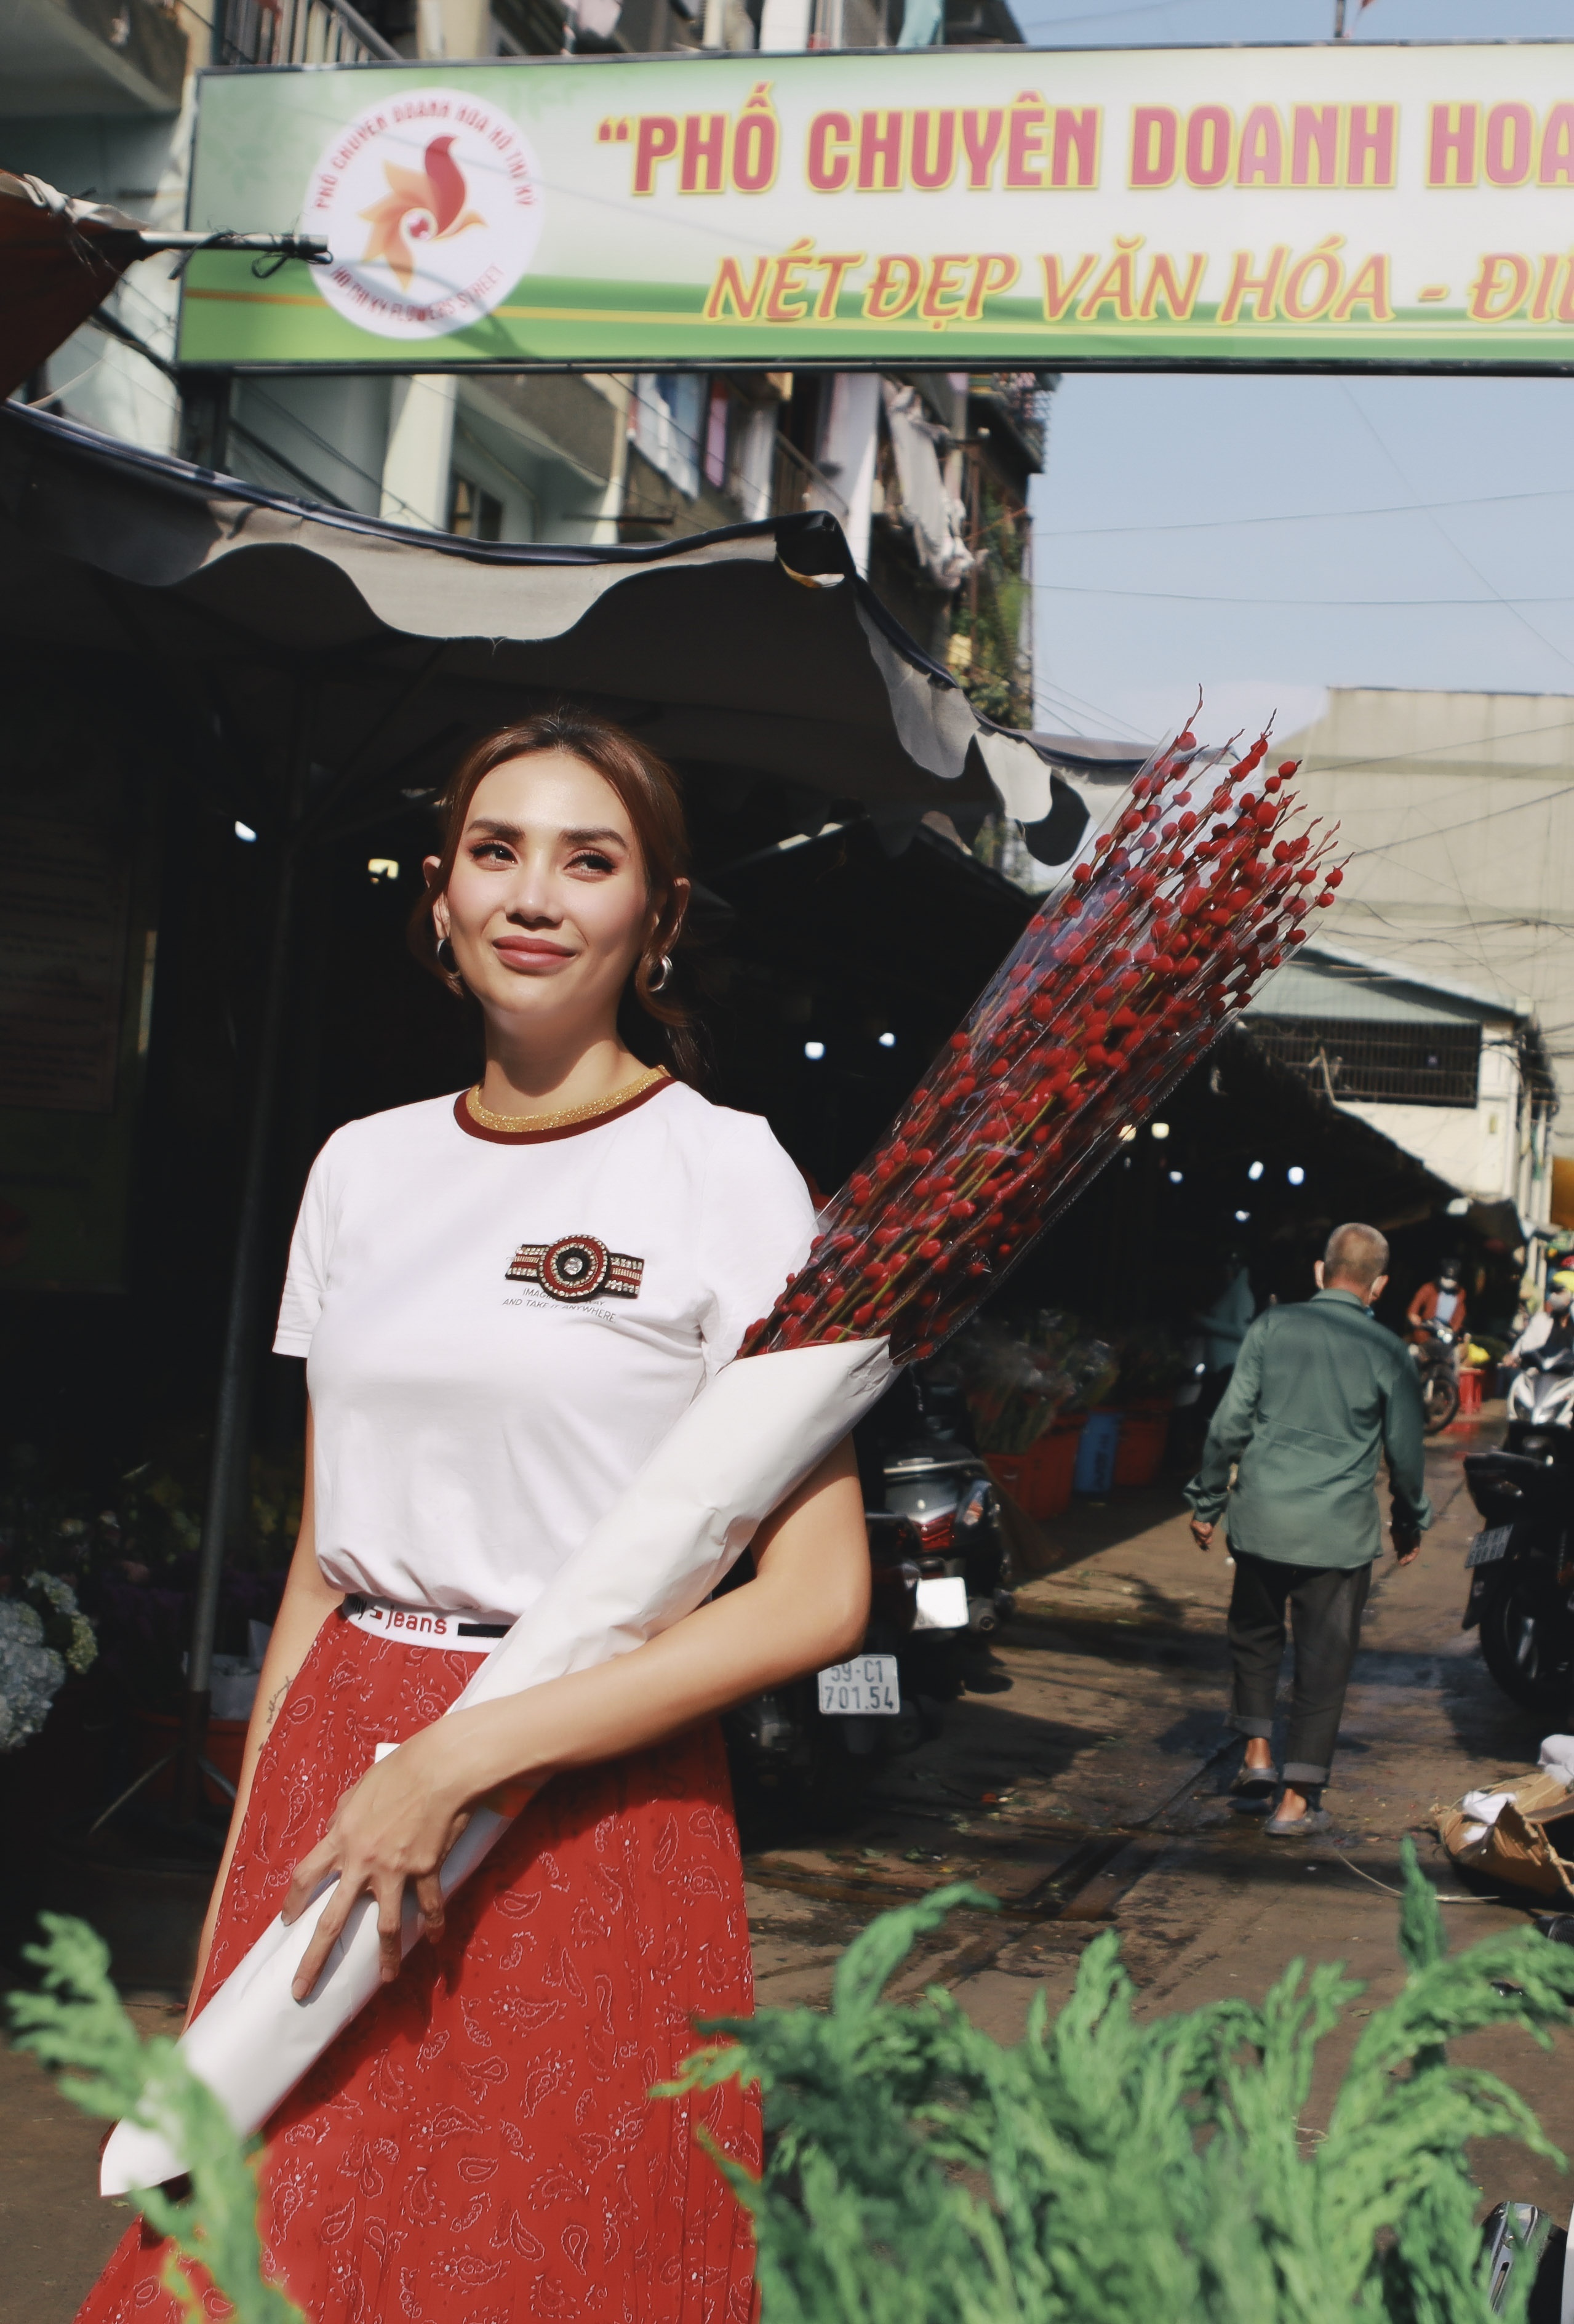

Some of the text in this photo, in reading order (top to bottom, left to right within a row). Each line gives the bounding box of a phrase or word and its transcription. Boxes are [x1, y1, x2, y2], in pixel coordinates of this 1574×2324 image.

[807, 90, 1100, 192] CHUYÊN
[1129, 102, 1397, 188] DOANH
[1426, 102, 1574, 188] HOA
[703, 236, 864, 323] NÉT
[861, 251, 1022, 332] ĐẸP
[1038, 234, 1208, 323] VĂN
[1216, 234, 1396, 326] HÓA
[502, 1298, 522, 1306] AND
[385, 1605, 447, 1635] jeans
[825, 1686, 894, 1709] 701.54
